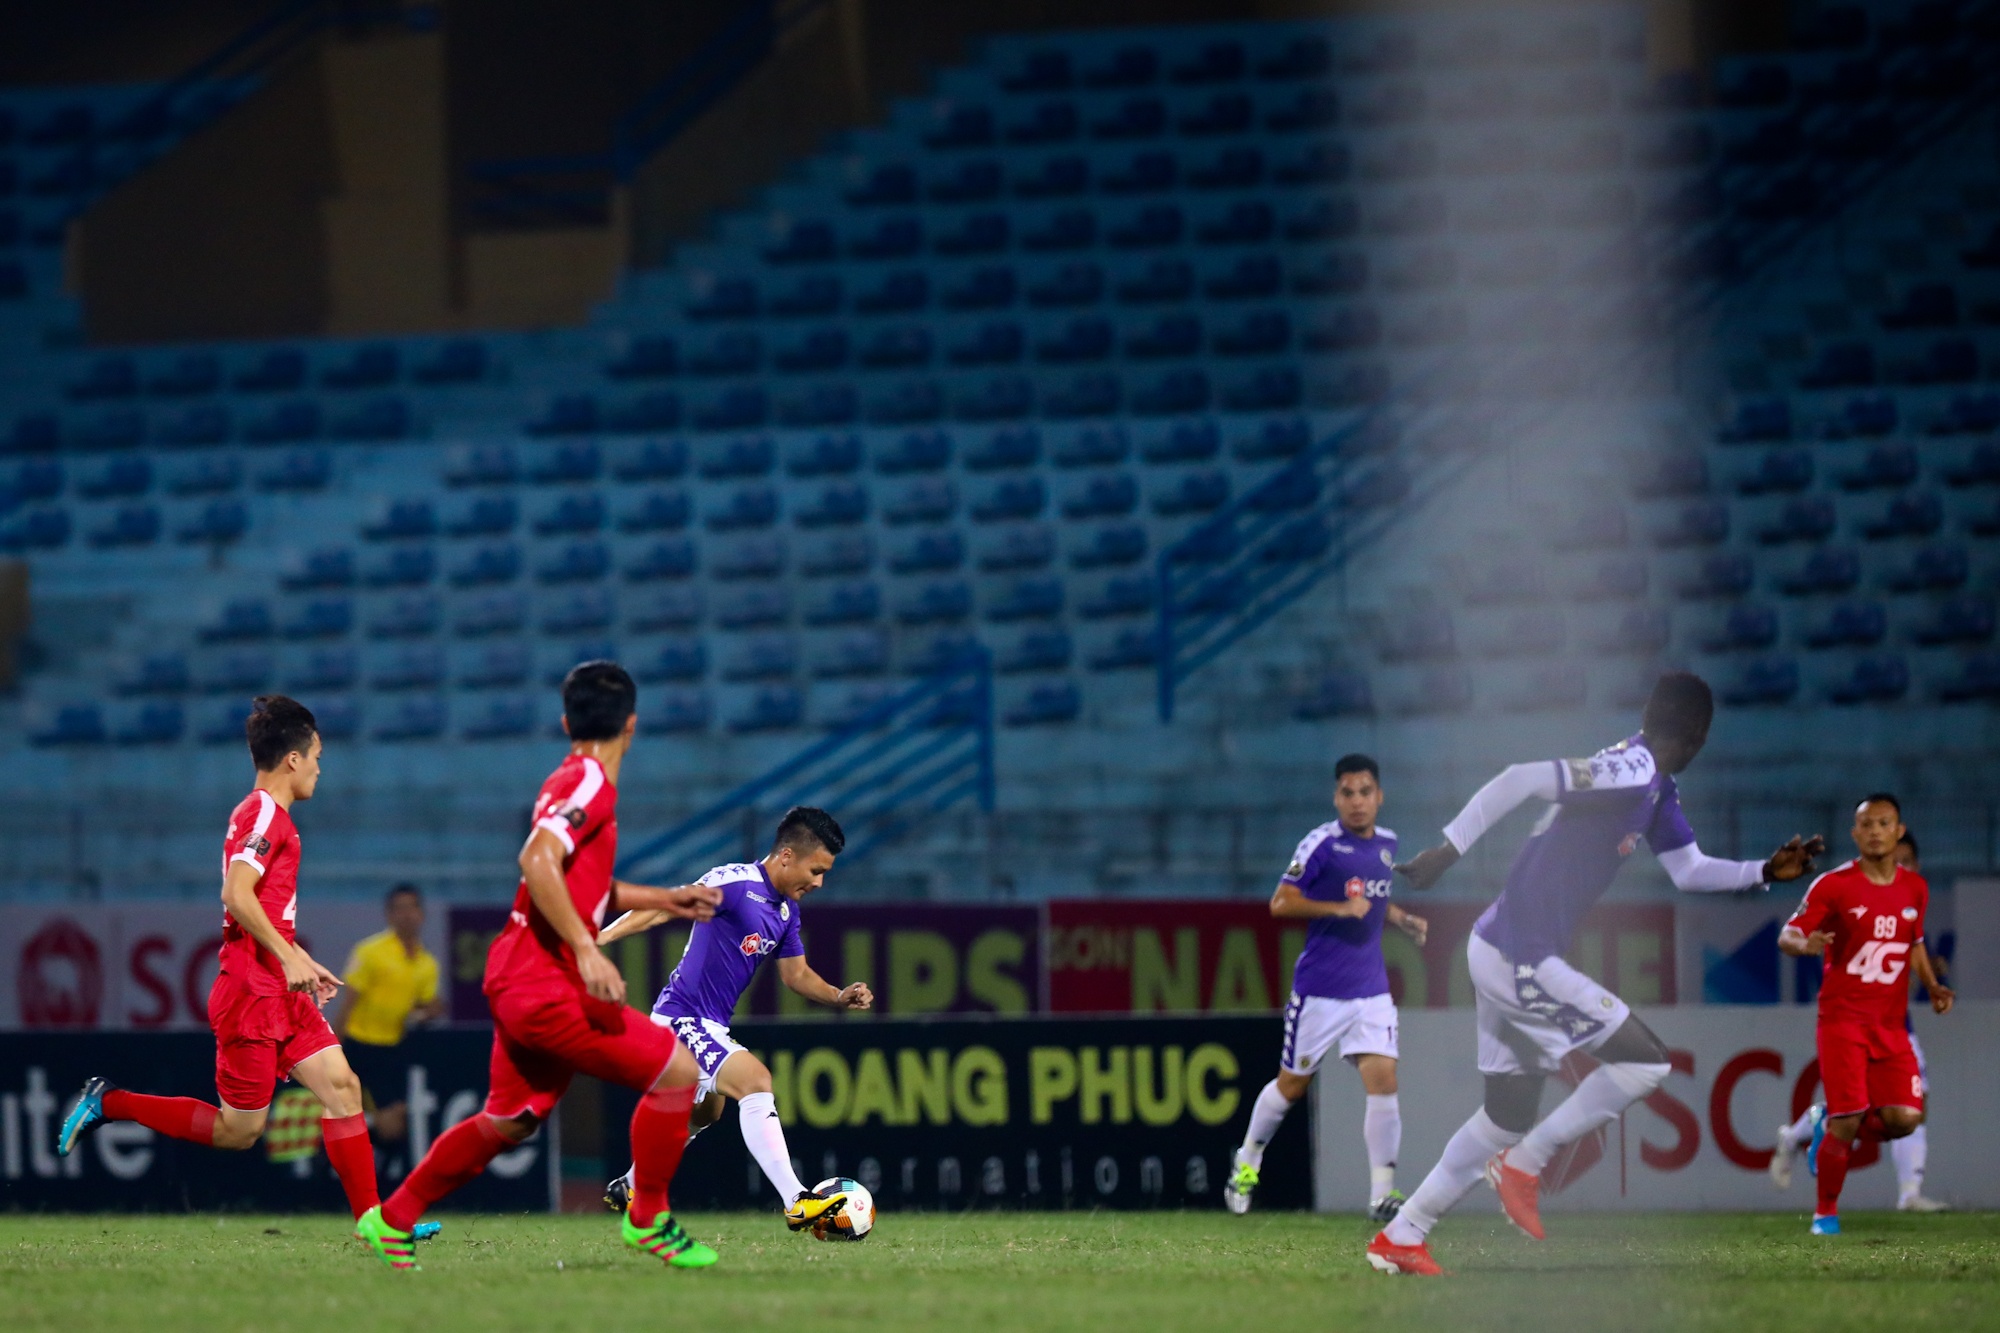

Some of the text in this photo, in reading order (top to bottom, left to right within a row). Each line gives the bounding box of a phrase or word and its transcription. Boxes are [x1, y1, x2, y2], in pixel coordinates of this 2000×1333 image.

[1873, 915, 1897, 939] 89
[1846, 940, 1910, 985] 4G
[1029, 1043, 1240, 1126] PHUC
